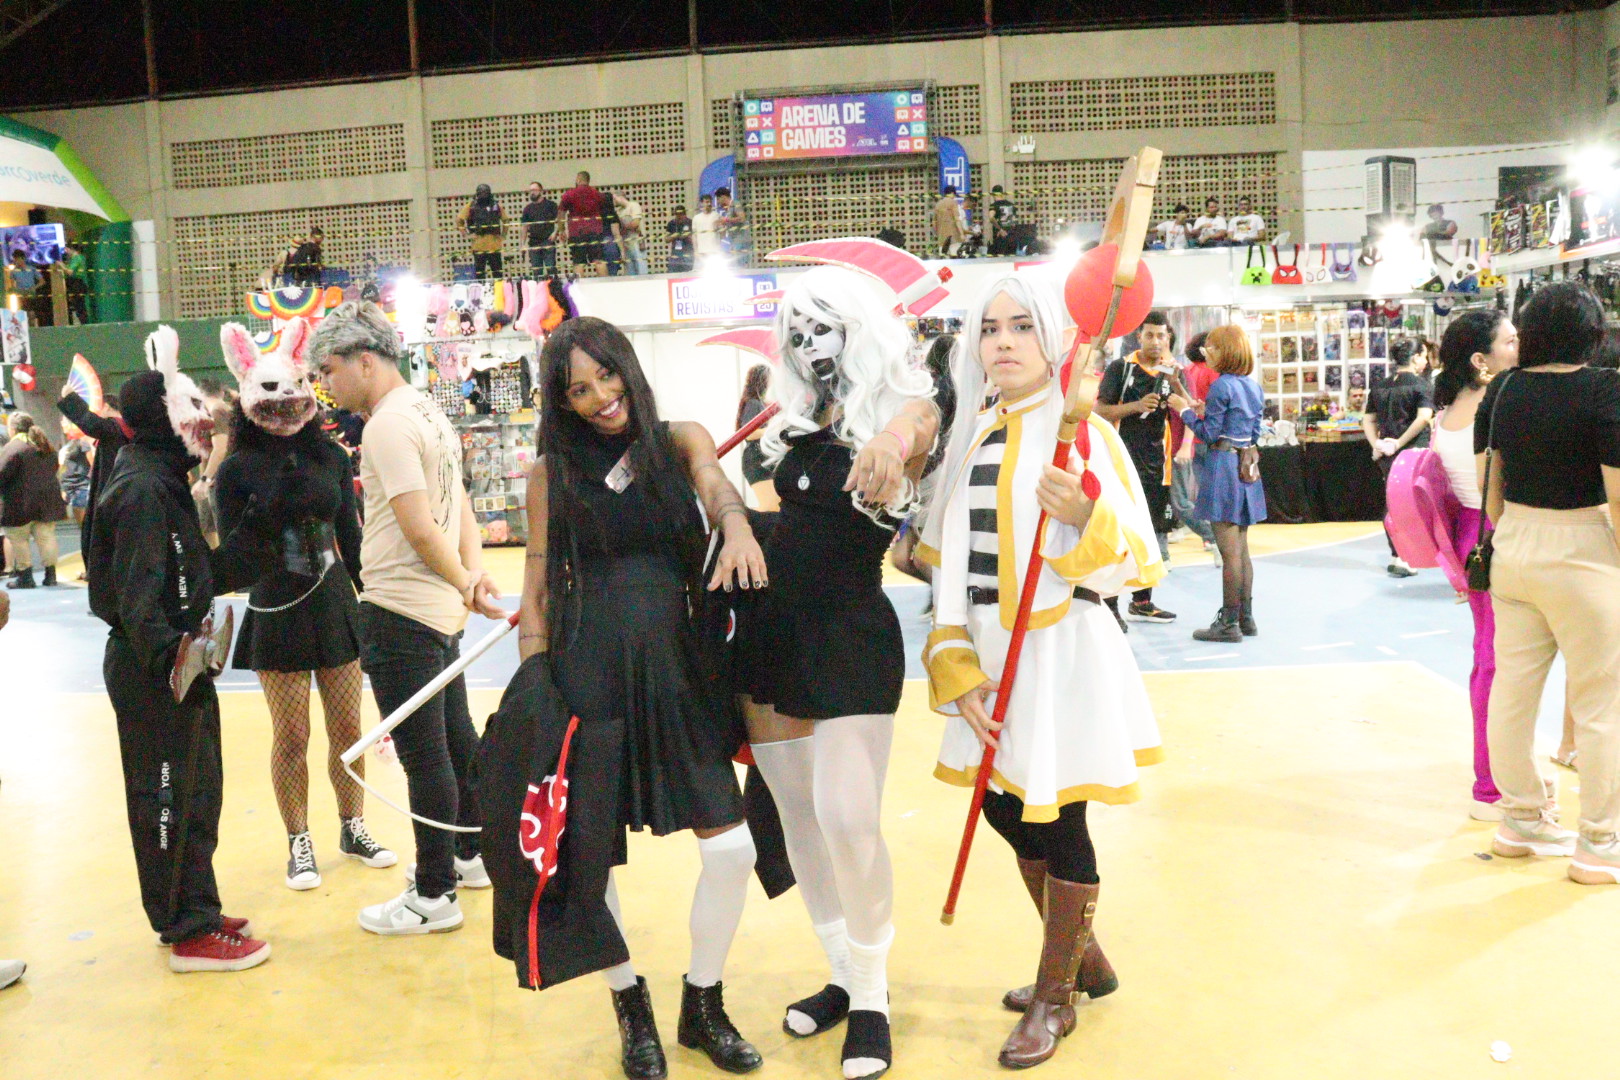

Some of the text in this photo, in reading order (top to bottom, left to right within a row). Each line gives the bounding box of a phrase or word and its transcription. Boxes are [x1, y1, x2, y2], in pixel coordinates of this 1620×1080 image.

[781, 102, 866, 128] ARENA DE
[781, 126, 847, 151] GAMES
[677, 302, 735, 316] REVISTAS
[178, 575, 187, 598] NEW
